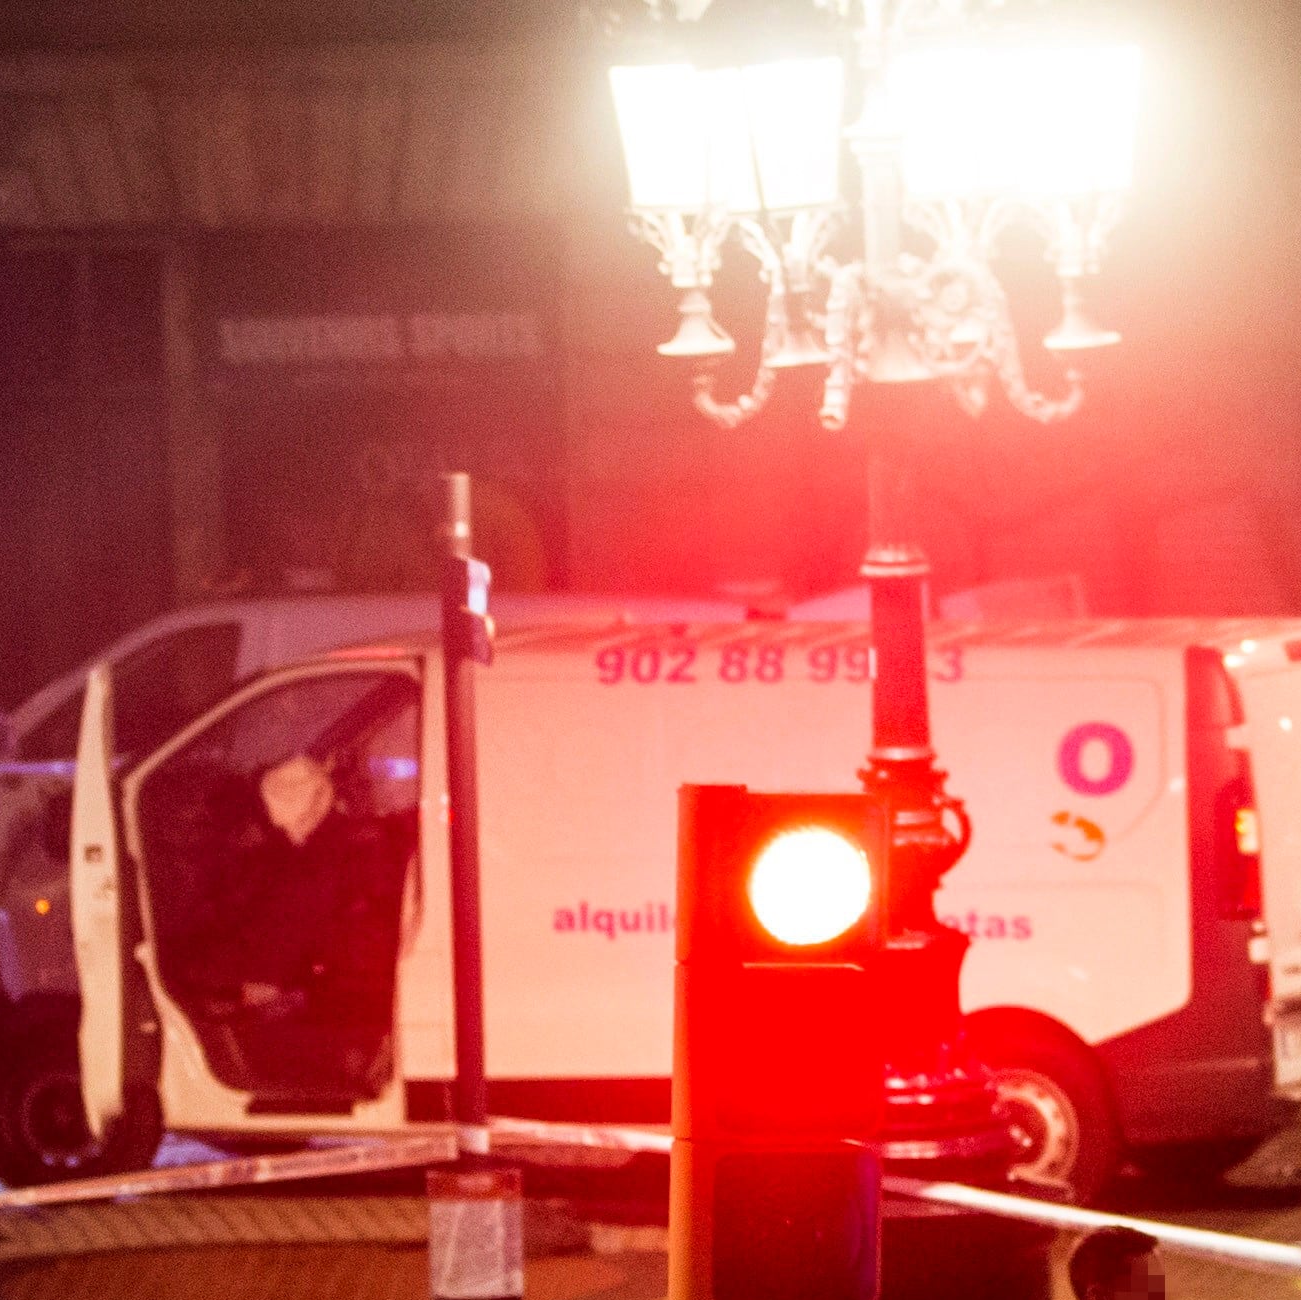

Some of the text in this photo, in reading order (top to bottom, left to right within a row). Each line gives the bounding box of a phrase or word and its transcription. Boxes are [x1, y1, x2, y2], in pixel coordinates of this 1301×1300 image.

[596, 646, 697, 685] 902
[718, 646, 785, 684] 88
[807, 646, 872, 684] 99
[552, 900, 672, 941] alquil
